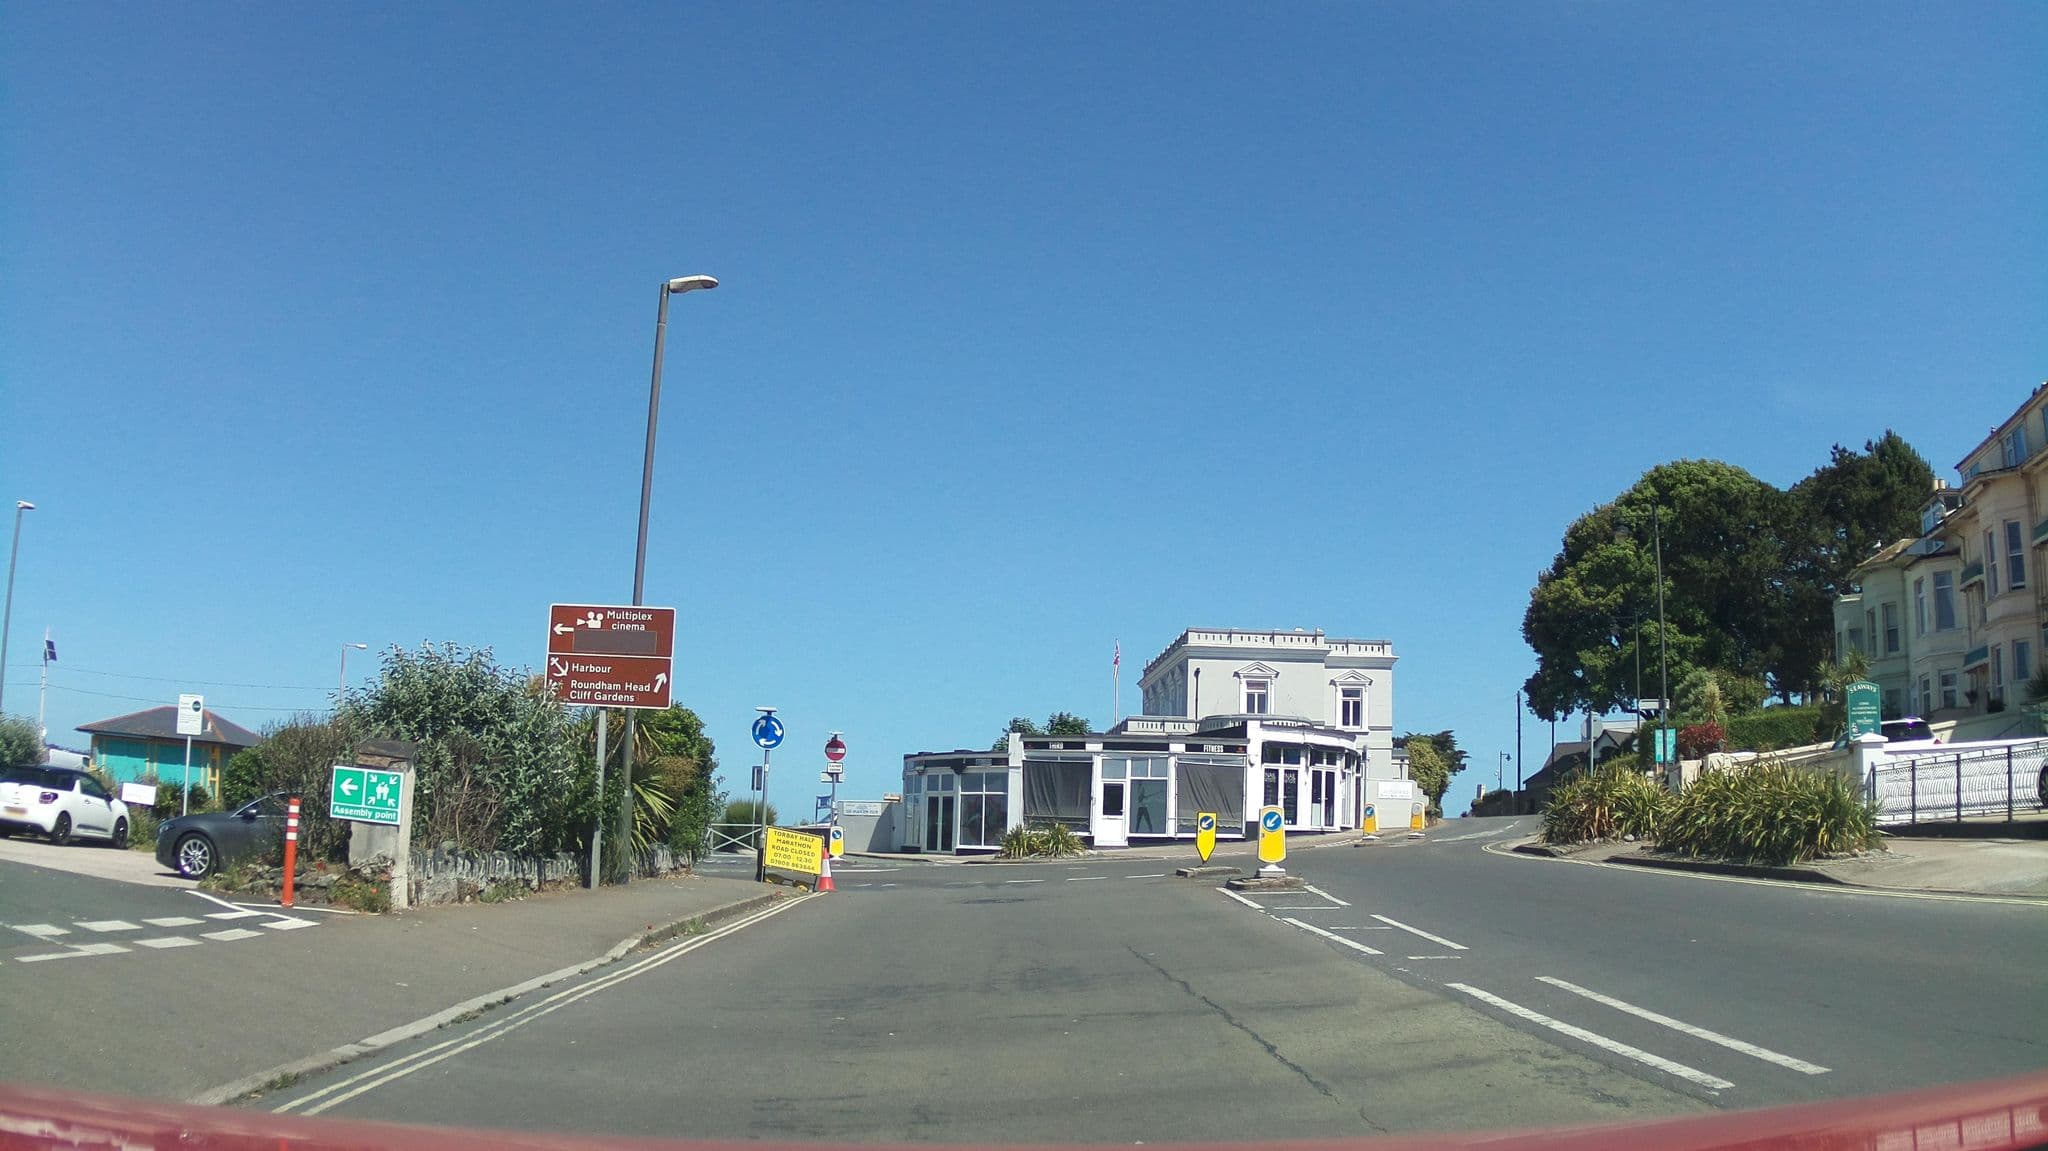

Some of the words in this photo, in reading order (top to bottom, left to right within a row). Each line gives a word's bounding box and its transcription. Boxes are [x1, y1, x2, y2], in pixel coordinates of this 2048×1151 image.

[606, 610, 653, 621] Multiplex
[611, 622, 646, 631] cinema
[571, 663, 612, 673] Harbour
[570, 680, 621, 691] Roundham
[624, 682, 651, 692] Head
[569, 690, 592, 700] Cliff
[594, 691, 635, 702] Gardens
[1203, 744, 1224, 753] FITNESS
[334, 805, 372, 818] Assembly
[375, 810, 396, 819] point
[774, 831, 798, 839] TORBAY
[777, 838, 812, 849] MARATHON
[791, 848, 815, 857] CLOSED
